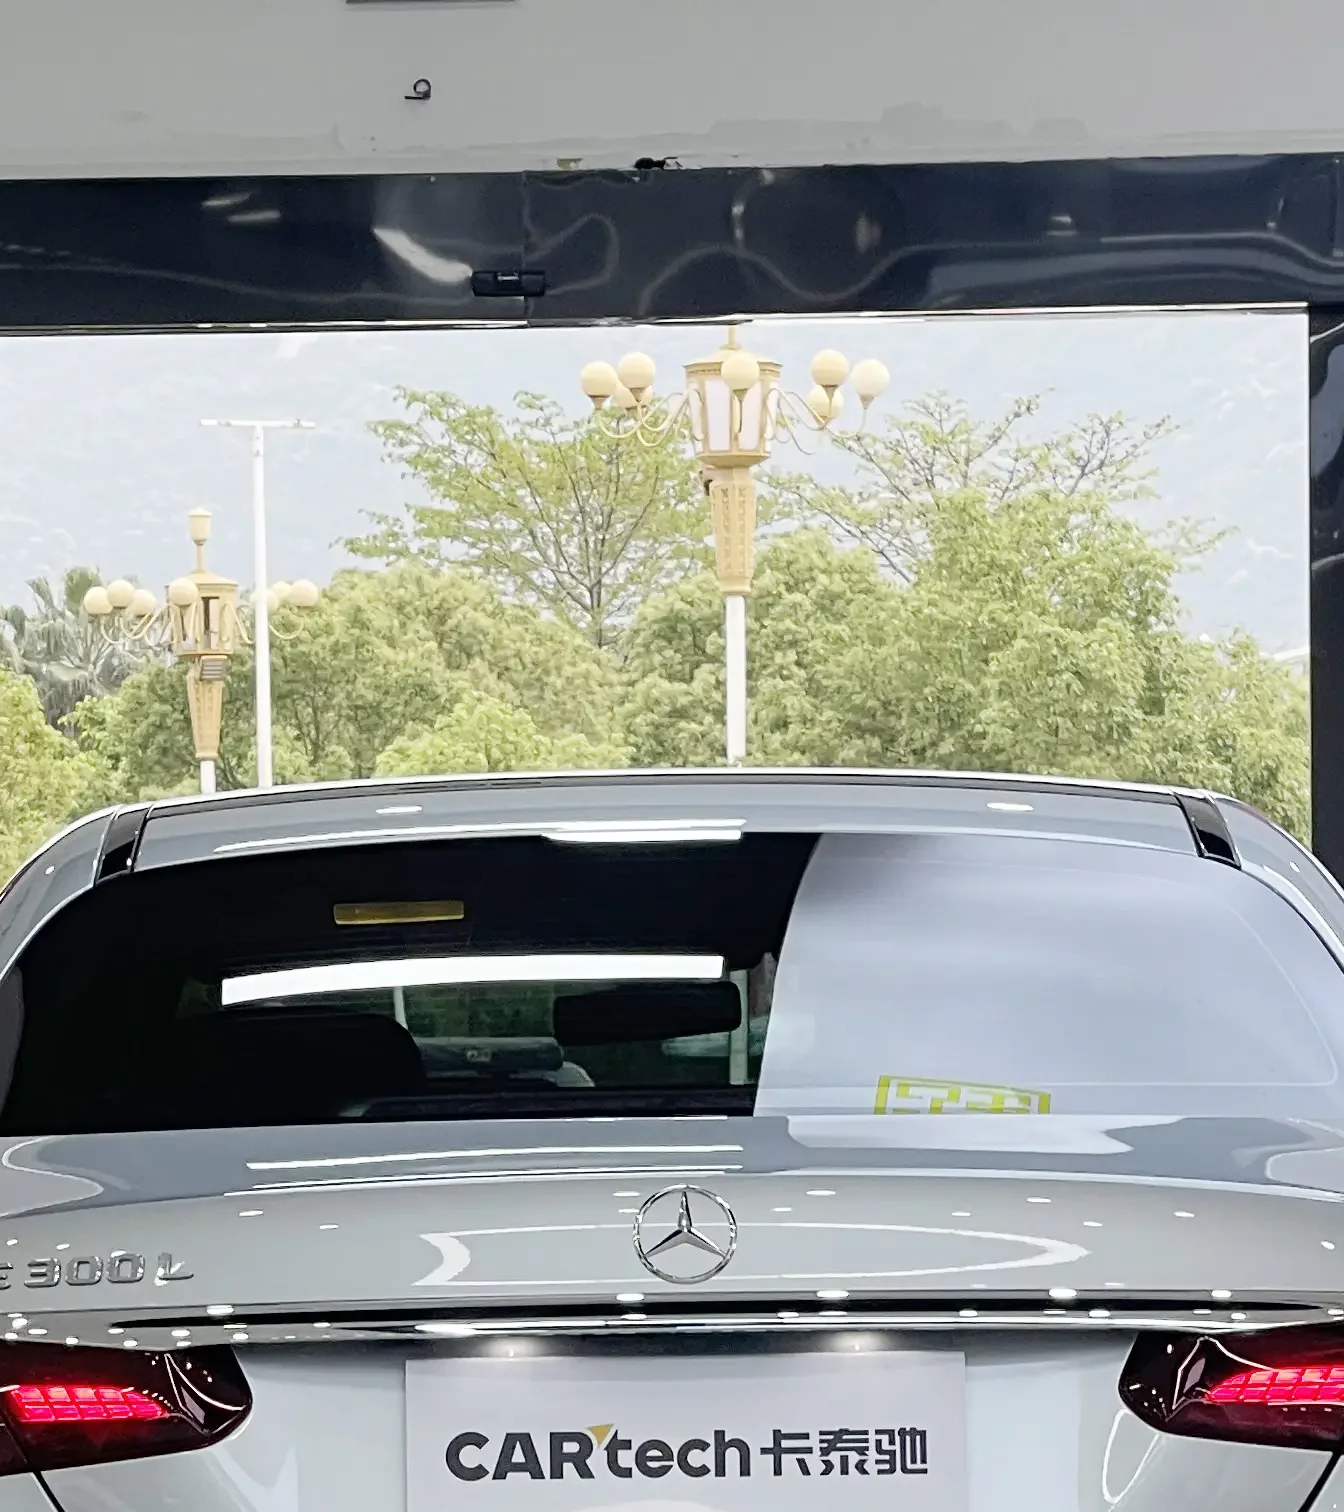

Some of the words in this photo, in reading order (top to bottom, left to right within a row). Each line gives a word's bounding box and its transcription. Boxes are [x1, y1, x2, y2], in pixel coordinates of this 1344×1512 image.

[24, 1252, 146, 1288] 300
[759, 1427, 929, 1478] 卡泰驰
